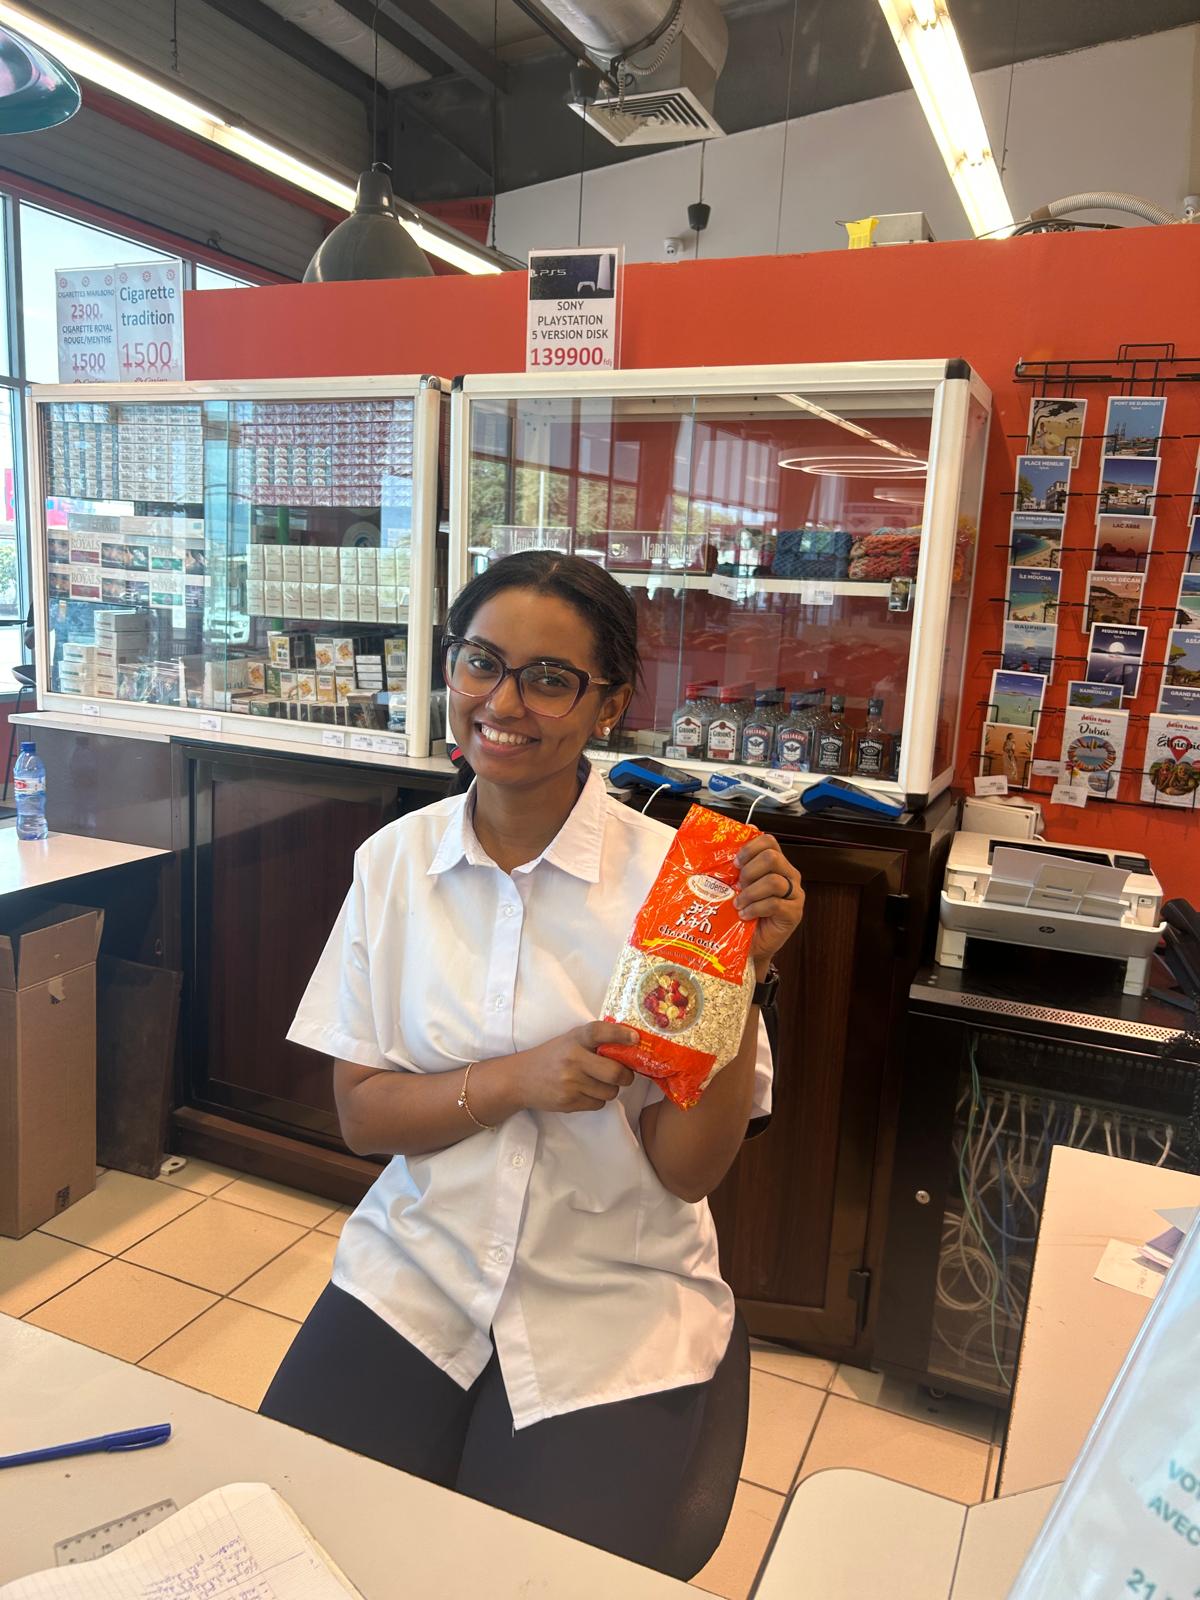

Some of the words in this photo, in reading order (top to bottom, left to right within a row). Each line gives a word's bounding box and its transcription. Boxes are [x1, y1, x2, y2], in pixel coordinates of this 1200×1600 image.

[57, 290, 85, 298] CIGARETTES
[119, 286, 175, 303] Cigarette
[71, 303, 99, 319] 2300
[557, 301, 584, 311] SONY
[121, 310, 175, 326] tradition
[537, 315, 603, 326] PLAYSTATION
[62, 324, 92, 334] CIGARETTE
[93, 323, 113, 333] ROYAL
[532, 331, 538, 340] 5
[541, 330, 583, 340] VERSION
[586, 329, 608, 339] DISK
[64, 335, 112, 345] ROUGE/MENTHE
[72, 352, 105, 371] 1500
[122, 340, 172, 368] 1500
[530, 347, 604, 366] 139900
[1078, 722, 1111, 736] Dubaï
[1168, 1458, 1200, 1501] VO
[1148, 1495, 1200, 1546] AVEC
